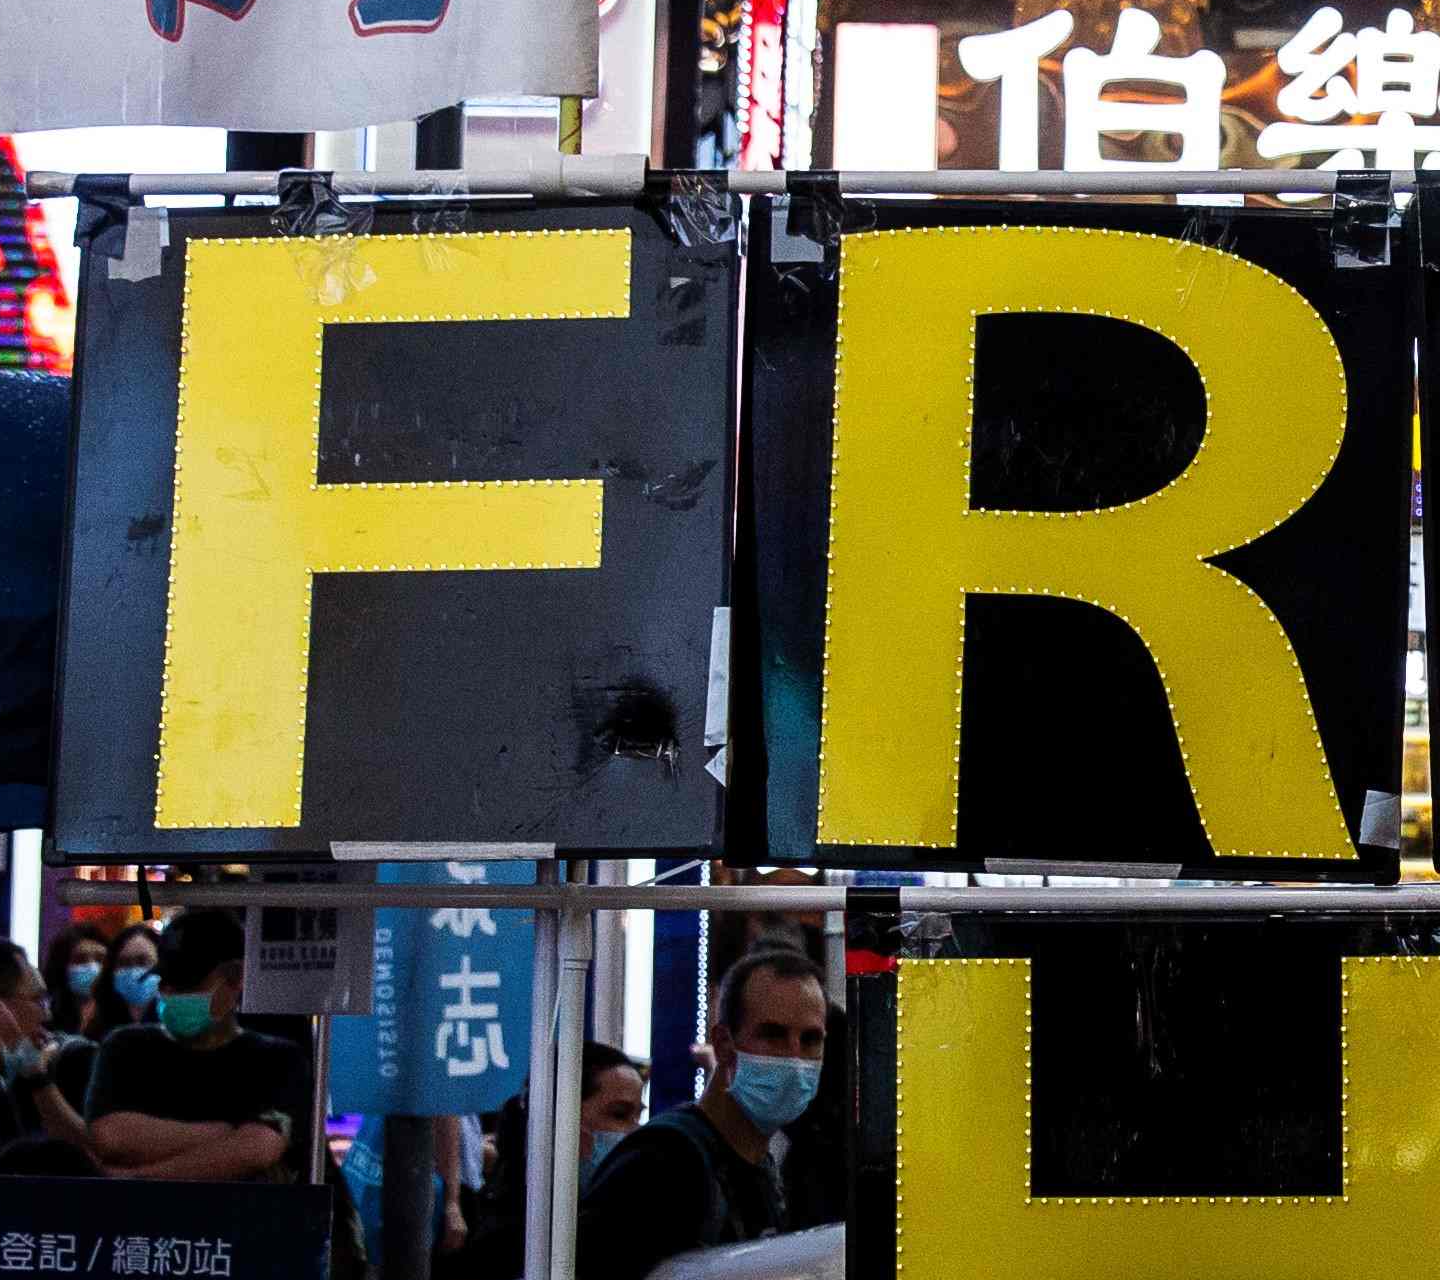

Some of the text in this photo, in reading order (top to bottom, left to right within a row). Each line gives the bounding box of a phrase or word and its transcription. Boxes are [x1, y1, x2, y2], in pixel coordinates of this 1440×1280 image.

[0, 1231, 78, 1273] 登記
[110, 1233, 232, 1278] 續約站
